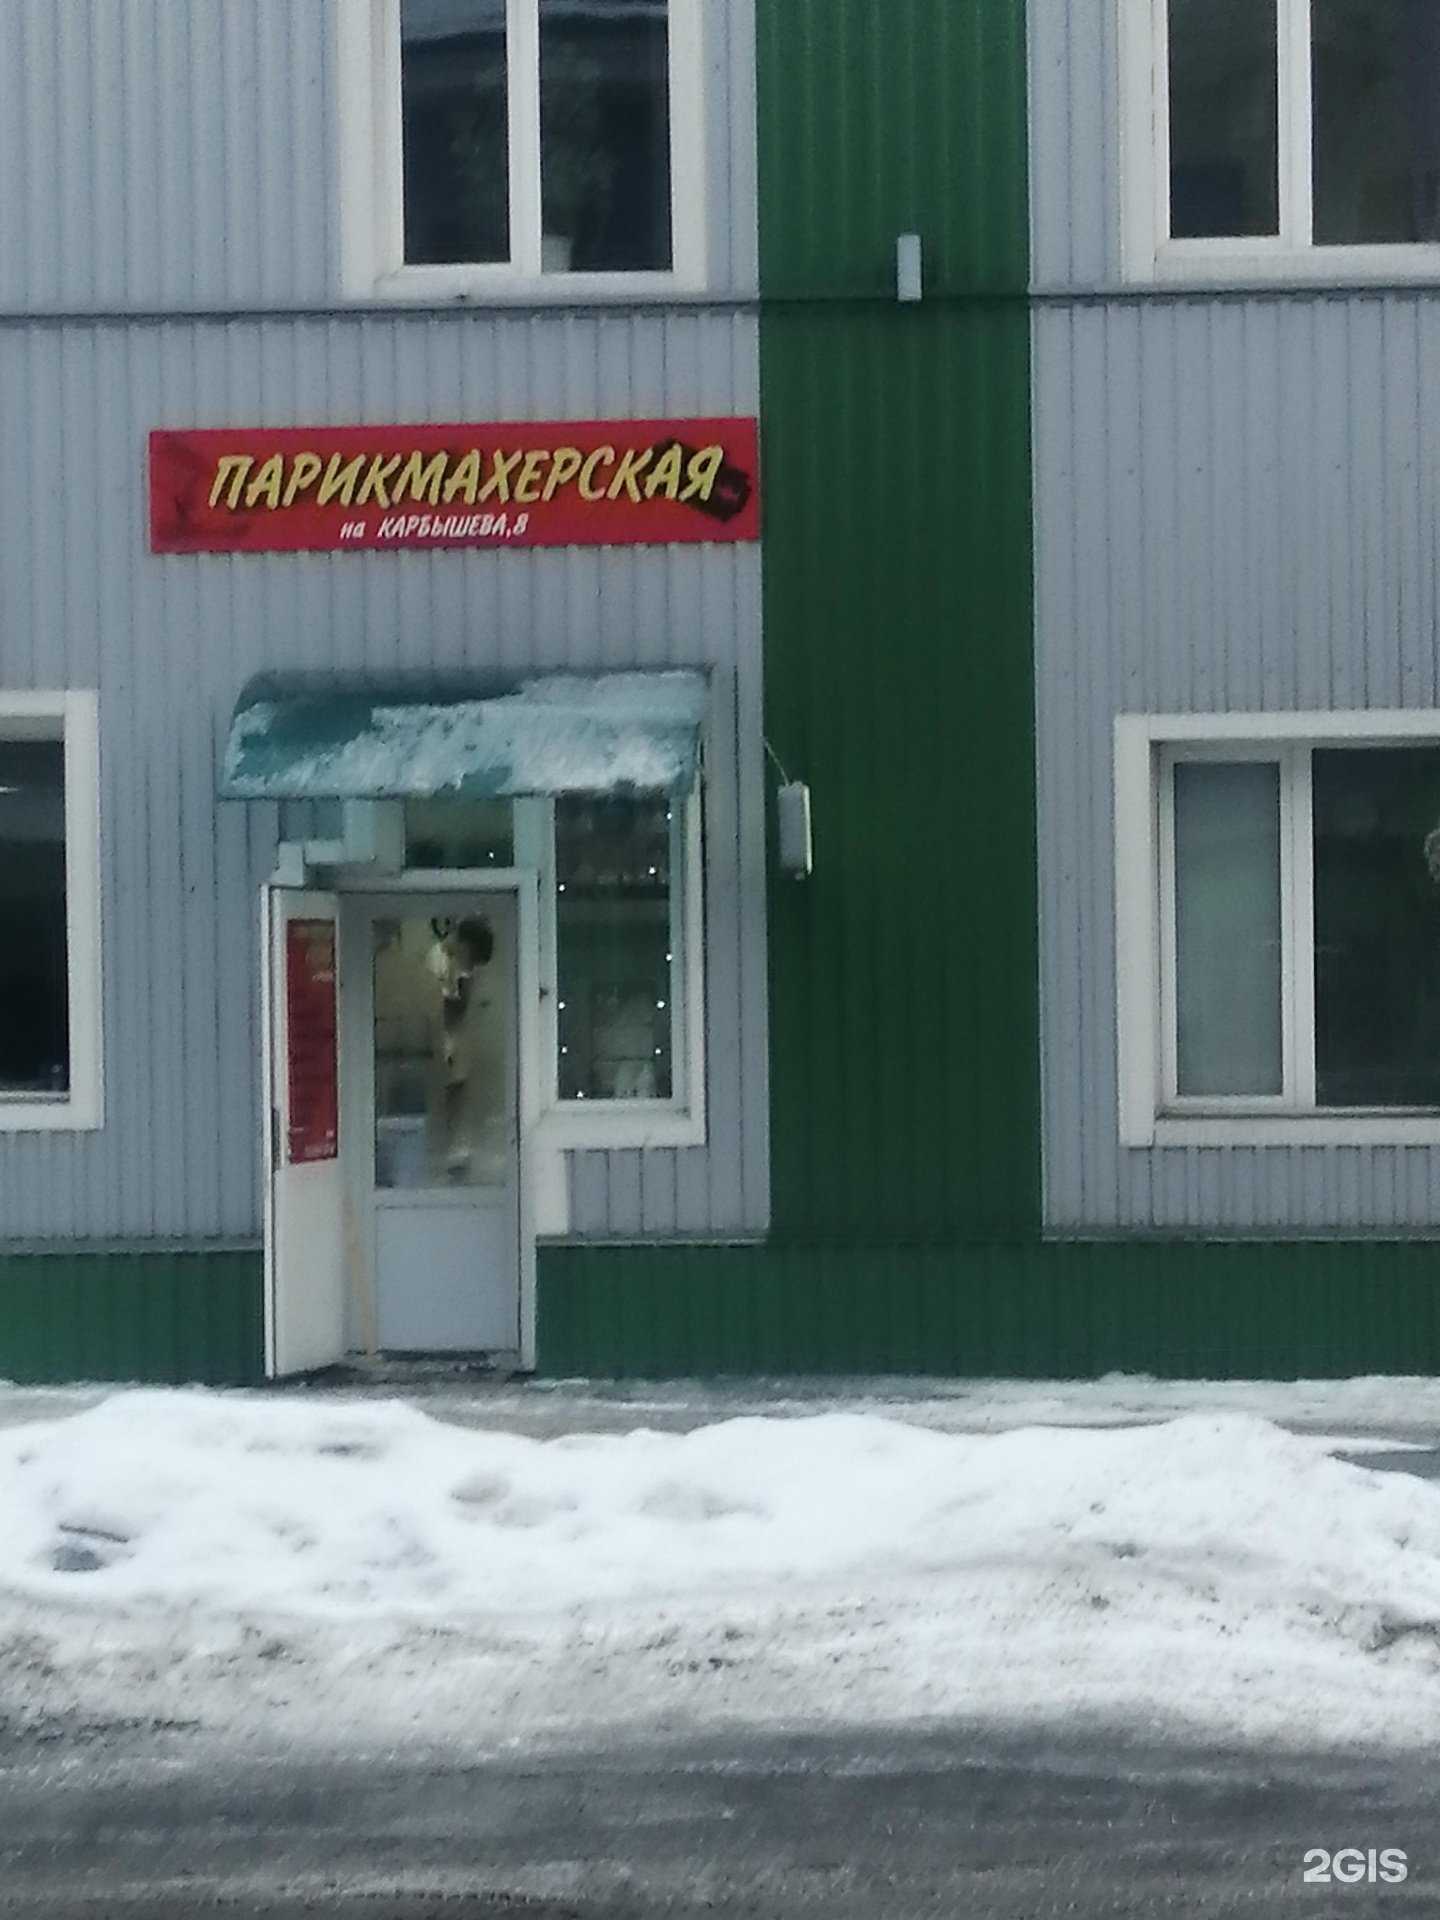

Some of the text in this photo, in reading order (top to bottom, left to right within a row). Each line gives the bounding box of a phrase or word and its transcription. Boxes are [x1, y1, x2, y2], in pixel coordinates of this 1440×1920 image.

[208, 445, 724, 509] ПАРИКМАХЕРСКАЯ
[340, 512, 529, 540] на КАРБЫШЕВА,8
